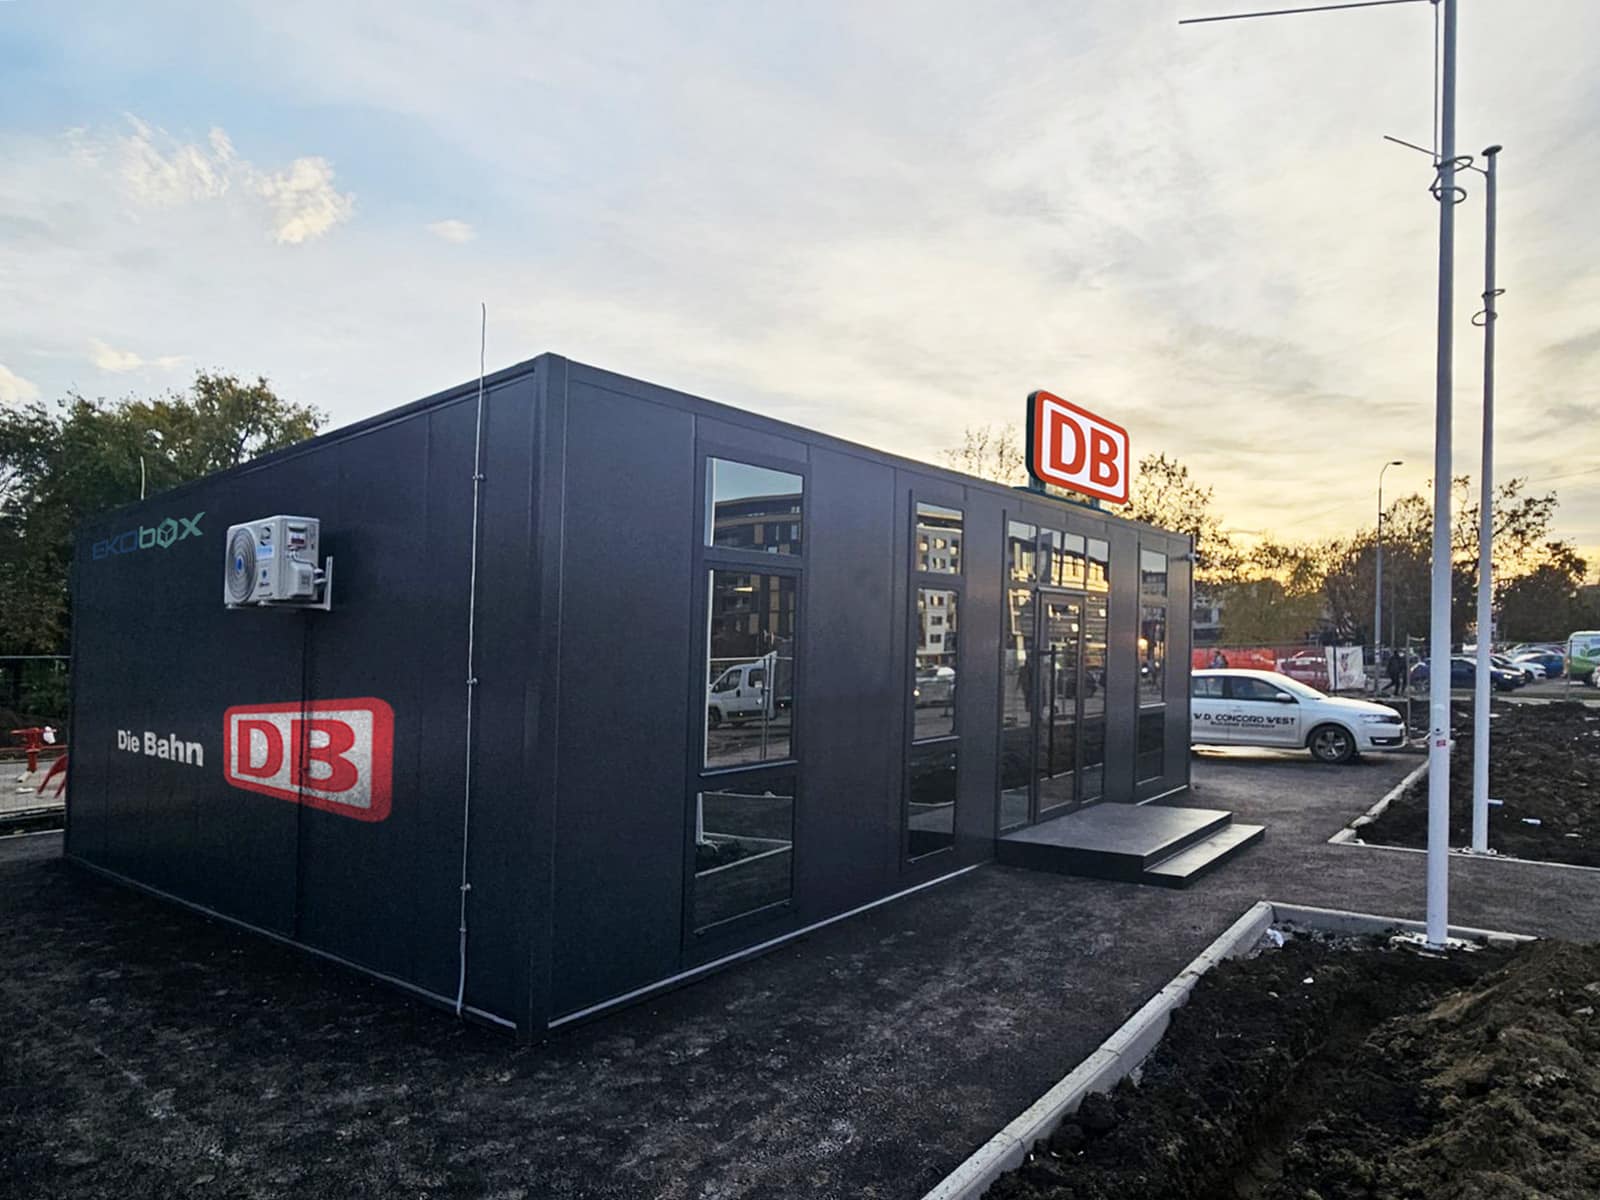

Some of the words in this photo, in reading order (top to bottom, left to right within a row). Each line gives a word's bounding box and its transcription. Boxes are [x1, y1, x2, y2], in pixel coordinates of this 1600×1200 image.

[1049, 409, 1119, 488] DB
[118, 729, 140, 753] Die
[144, 731, 204, 768] Bahn
[237, 719, 359, 793] DB
[1215, 713, 1264, 724] CONCORD
[1265, 716, 1296, 726] WEST
